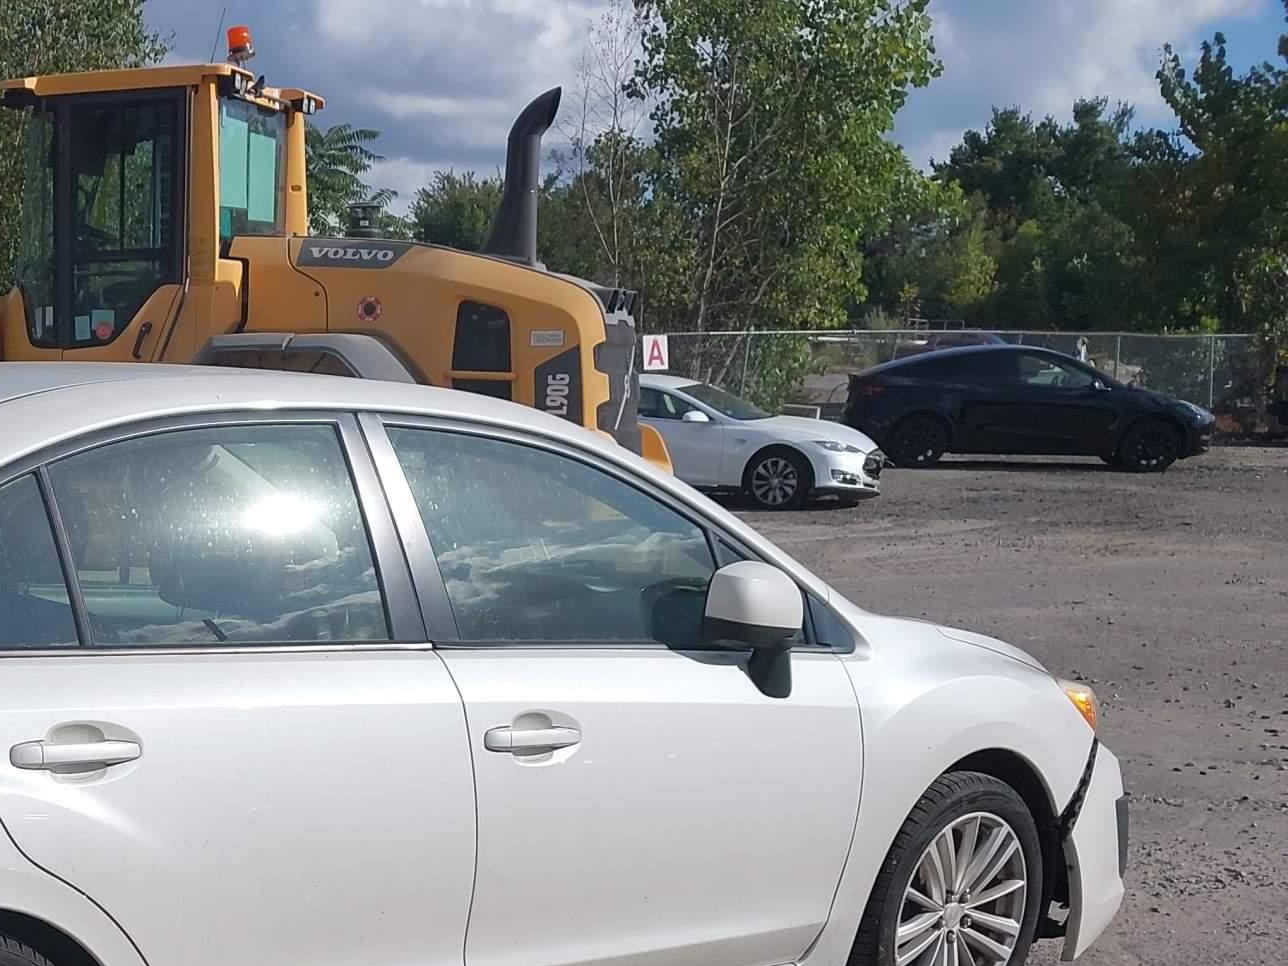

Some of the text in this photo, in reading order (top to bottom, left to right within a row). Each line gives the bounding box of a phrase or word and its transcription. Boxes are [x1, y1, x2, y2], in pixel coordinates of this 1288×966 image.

[310, 247, 394, 261] VOLVO
[648, 339, 665, 366] A
[545, 373, 570, 416] L90G
